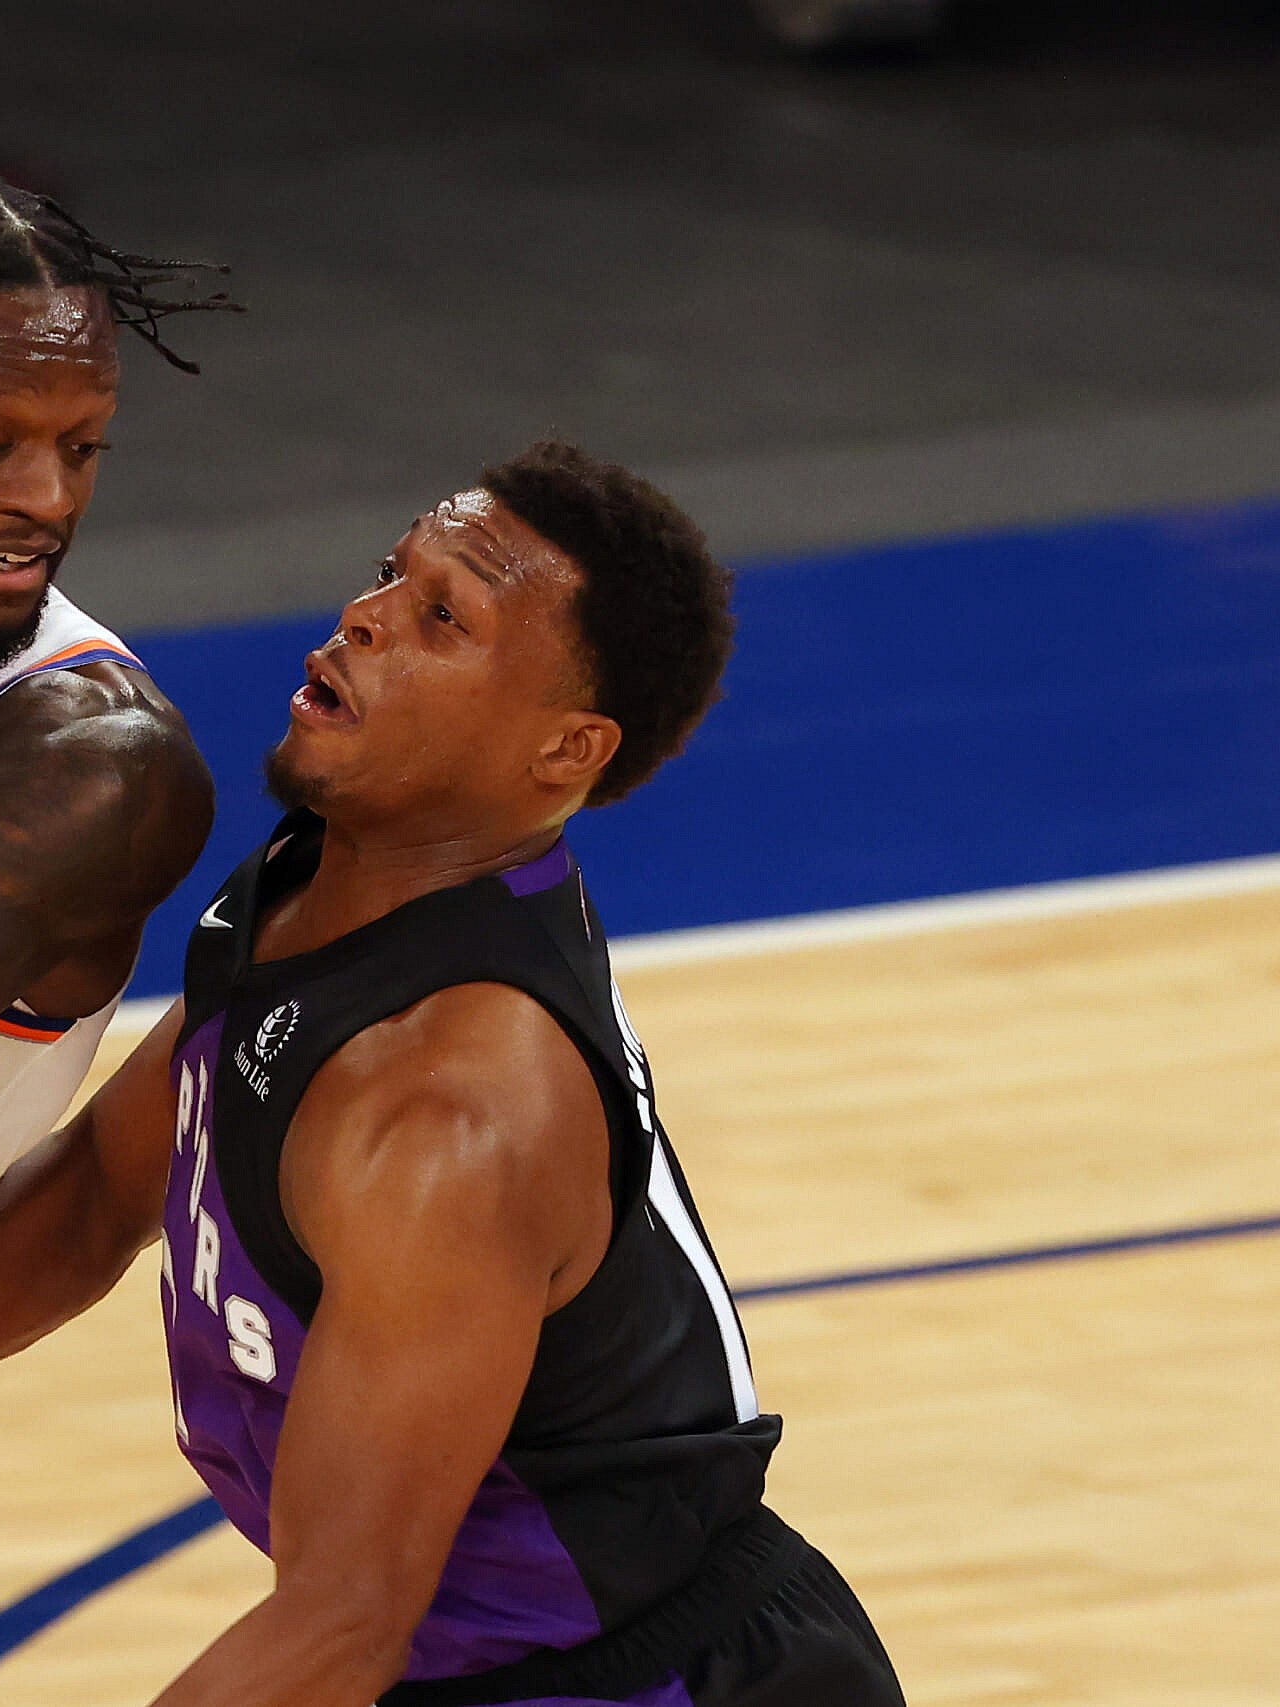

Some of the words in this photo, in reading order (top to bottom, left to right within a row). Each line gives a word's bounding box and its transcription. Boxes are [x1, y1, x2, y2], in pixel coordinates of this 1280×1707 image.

[233, 1041, 251, 1077] Sun
[248, 1064, 270, 1102] Life
[176, 1055, 277, 1384] PTORS
